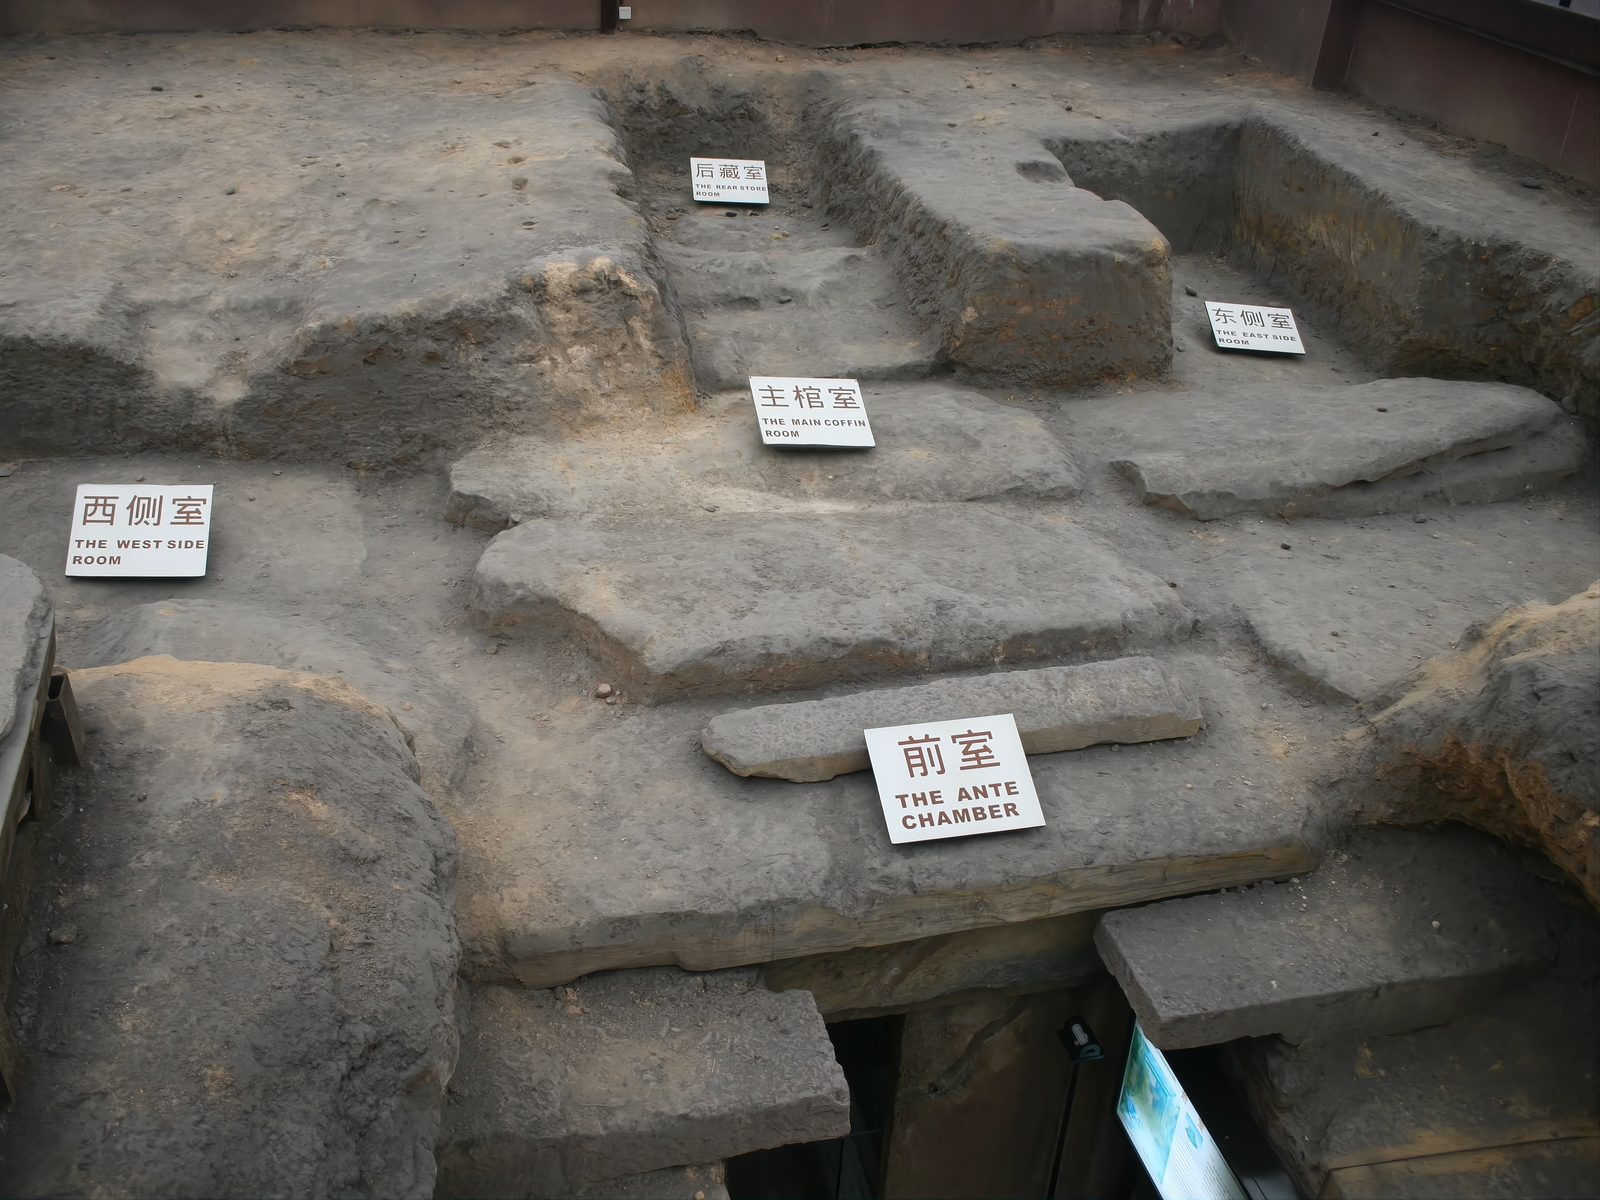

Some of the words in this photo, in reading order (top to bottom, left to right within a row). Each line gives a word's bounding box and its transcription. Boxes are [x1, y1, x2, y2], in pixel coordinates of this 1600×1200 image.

[696, 163, 763, 180] 后藏室
[1212, 307, 1293, 329] 东侧室
[1216, 329, 1237, 337] THE
[1272, 334, 1297, 342] SIDE
[1218, 338, 1250, 346] ROOM
[758, 385, 860, 409] 主棺室
[762, 417, 786, 426] THE
[791, 418, 821, 426] MAIN
[824, 419, 866, 427] COFFIN
[765, 430, 800, 438] ROOM
[82, 494, 207, 527] 西侧室
[75, 539, 107, 549] THE
[117, 539, 163, 549] WEST
[167, 540, 205, 549] SIDE
[72, 555, 121, 565] ROOM
[898, 729, 1000, 778] 前室
[895, 790, 944, 809] THE
[957, 780, 1019, 802] ANTE
[901, 802, 1020, 830] CHAMBER
